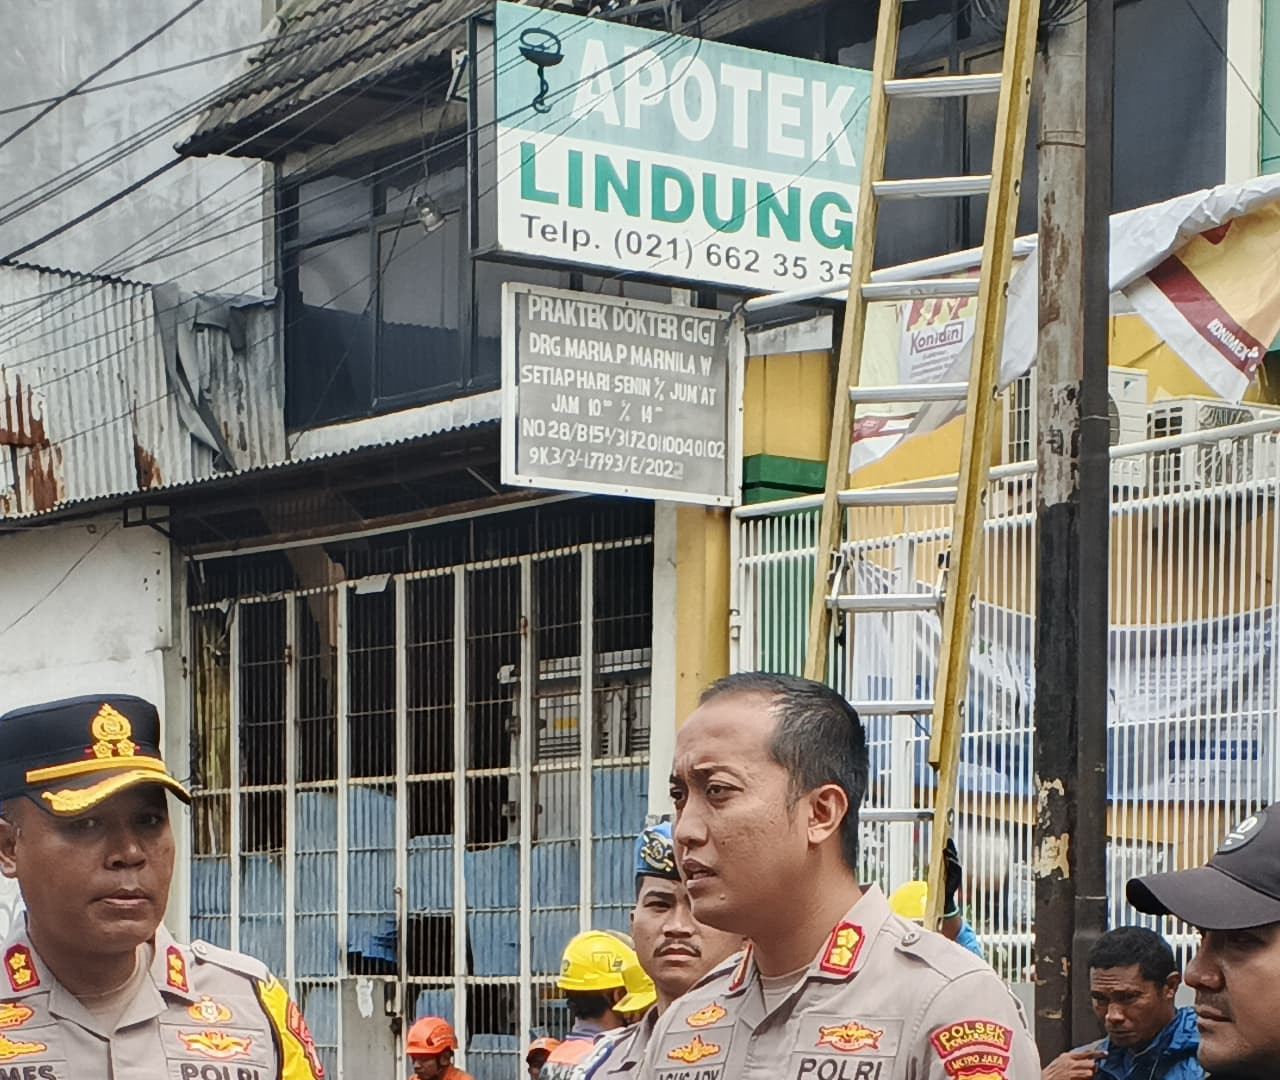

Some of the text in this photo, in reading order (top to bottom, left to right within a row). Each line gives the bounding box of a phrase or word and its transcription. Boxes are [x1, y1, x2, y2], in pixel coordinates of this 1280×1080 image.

[570, 38, 858, 168] APOTEK
[520, 141, 854, 251] LINDUNG
[520, 214, 600, 253] Telp.
[614, 228, 693, 269] (021)
[706, 243, 760, 273] 662
[772, 253, 807, 281] 35
[528, 295, 715, 346] PRAKTEK DOKTER GIGI
[910, 322, 963, 355] Konidin
[521, 365, 575, 387] SETIAP
[615, 375, 651, 397] SENIN
[551, 393, 580, 415] JAM
[522, 418, 545, 437] NO
[939, 1021, 1006, 1046] POLSEK
